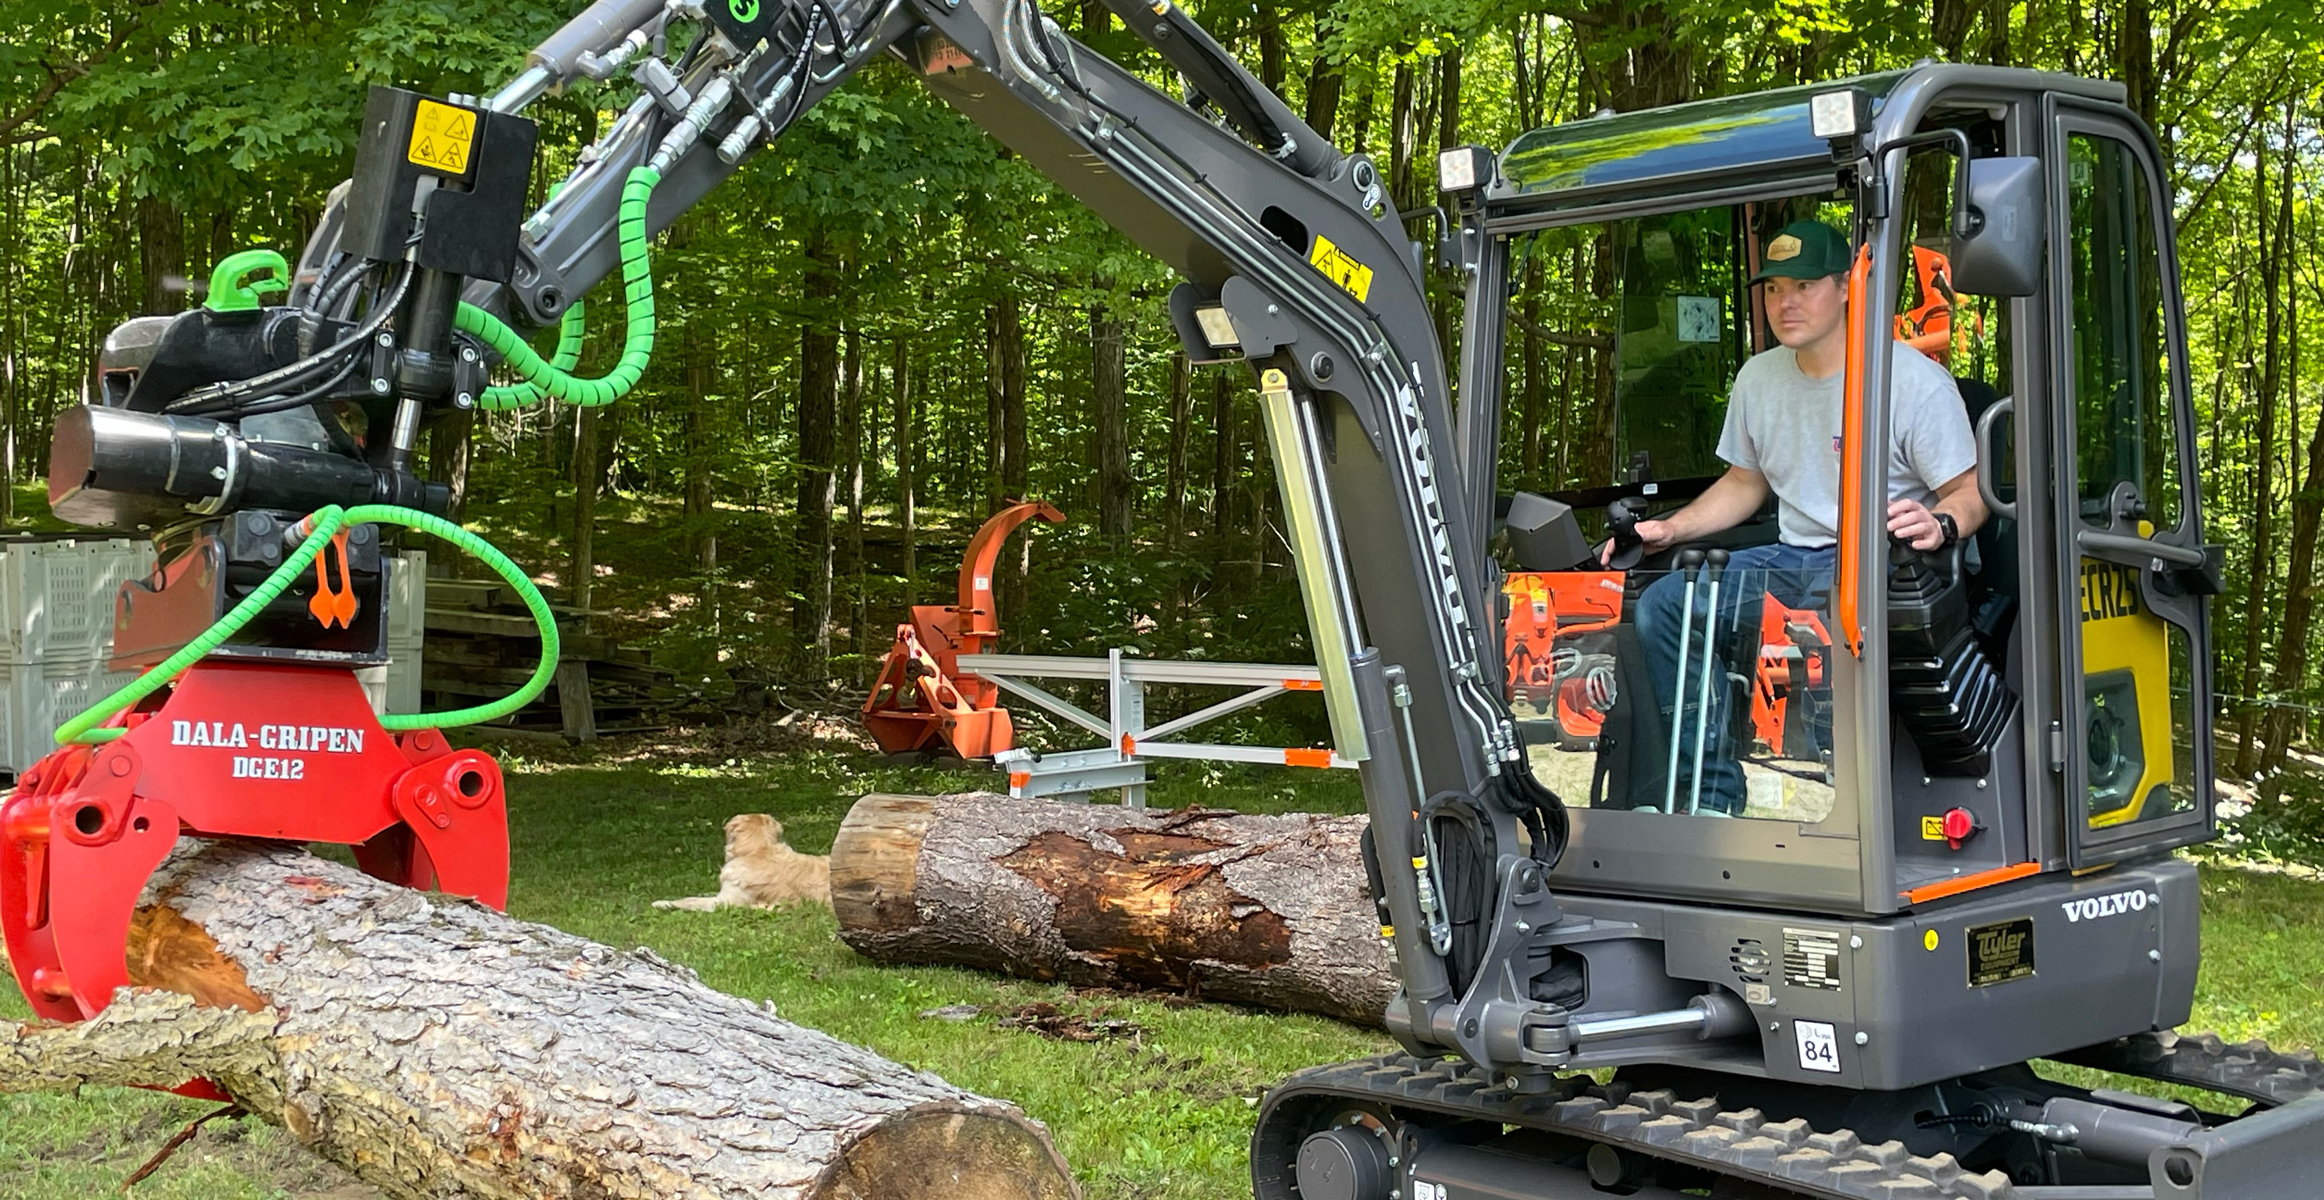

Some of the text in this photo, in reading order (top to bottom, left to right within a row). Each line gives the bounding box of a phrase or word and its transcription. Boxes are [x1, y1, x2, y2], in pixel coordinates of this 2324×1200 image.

[171, 720, 365, 754] DALA-GRIPEN
[232, 756, 305, 779] DGE12
[2061, 889, 2147, 923] VOLVO
[1976, 928, 2027, 962] Tyler
[1804, 1040, 1833, 1063] 84
